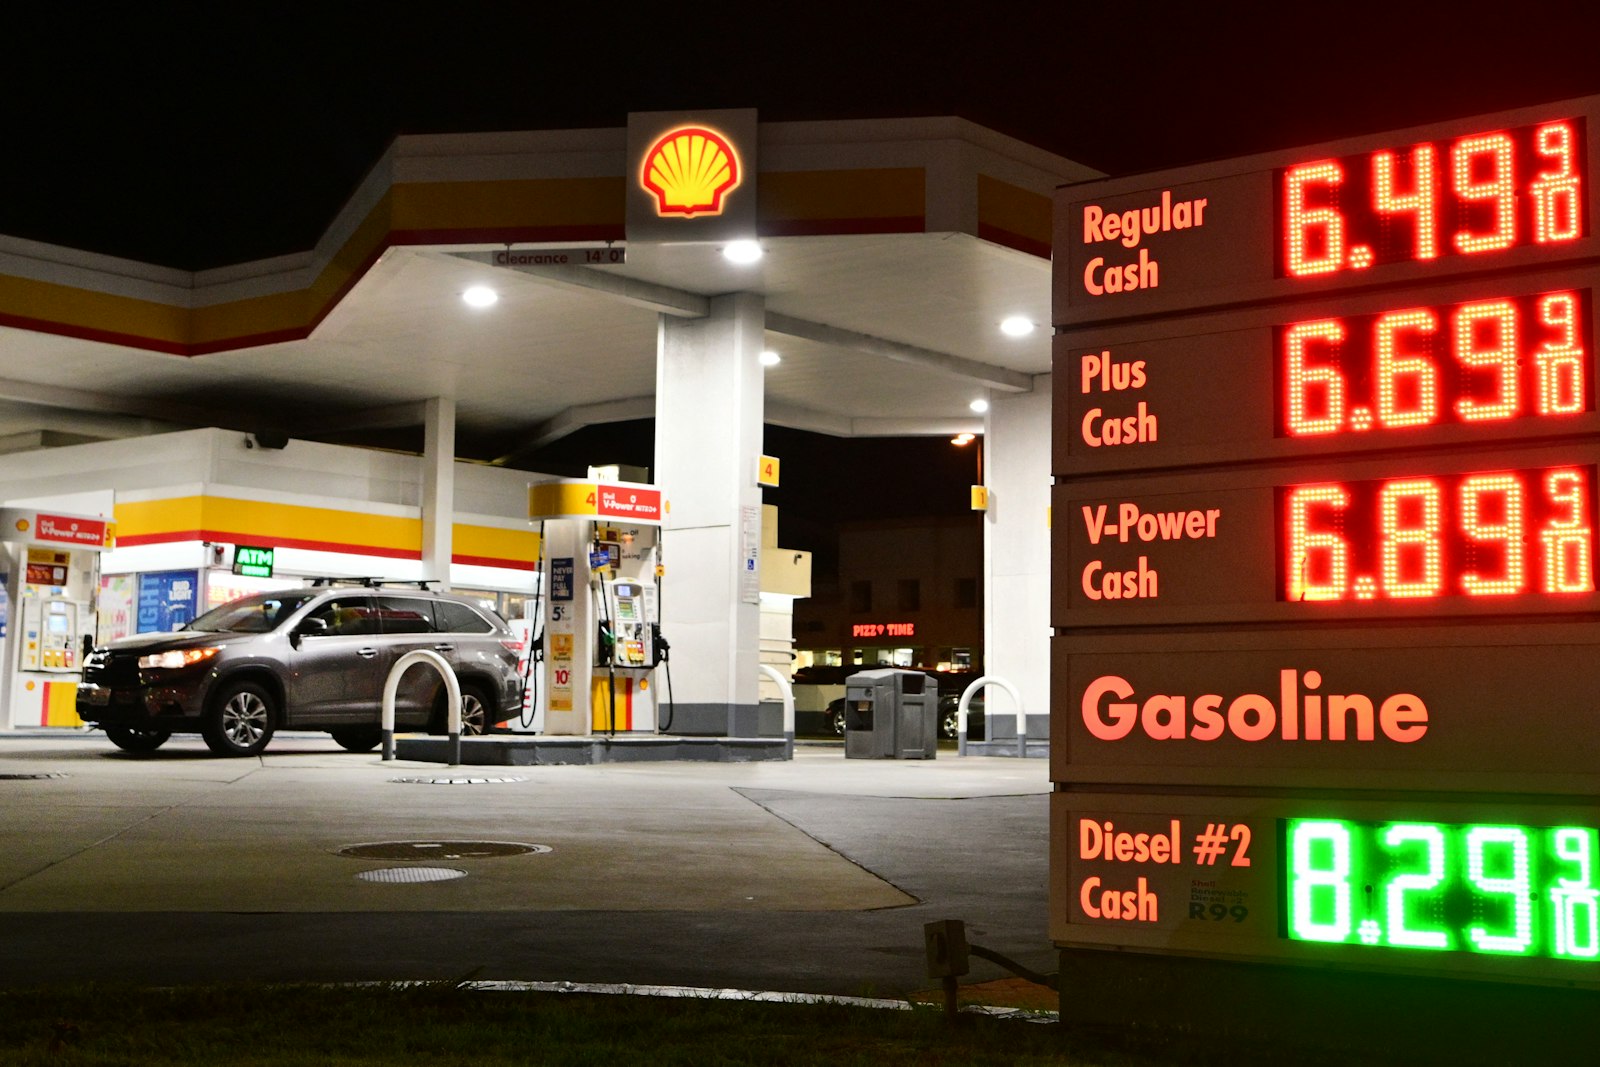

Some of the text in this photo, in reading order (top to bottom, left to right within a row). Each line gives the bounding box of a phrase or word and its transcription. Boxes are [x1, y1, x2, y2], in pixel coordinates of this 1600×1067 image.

[1083, 190, 1208, 248] Regular
[1287, 135, 1515, 276] 6.49
[496, 252, 569, 264] Clearance
[1083, 248, 1159, 296] Cash
[1081, 350, 1147, 394] Plus
[1287, 301, 1518, 435] 6.69
[1081, 401, 1158, 448] Cash
[765, 463, 773, 478] 4
[585, 491, 597, 508] 4
[602, 499, 635, 511] V-Power
[105, 527, 112, 541] 5
[1081, 502, 1221, 545] V-Power
[1288, 475, 1525, 602] 6.89
[236, 548, 273, 566] ATM
[1081, 555, 1159, 601] Cash
[138, 575, 160, 633] IGHT
[886, 623, 915, 636] TIME
[1081, 668, 1429, 743] Gasoline
[1079, 818, 1252, 867] Diesel #2
[1079, 876, 1158, 922] Cash
[1291, 821, 1533, 953] 8.29
[1188, 901, 1249, 923] R99
